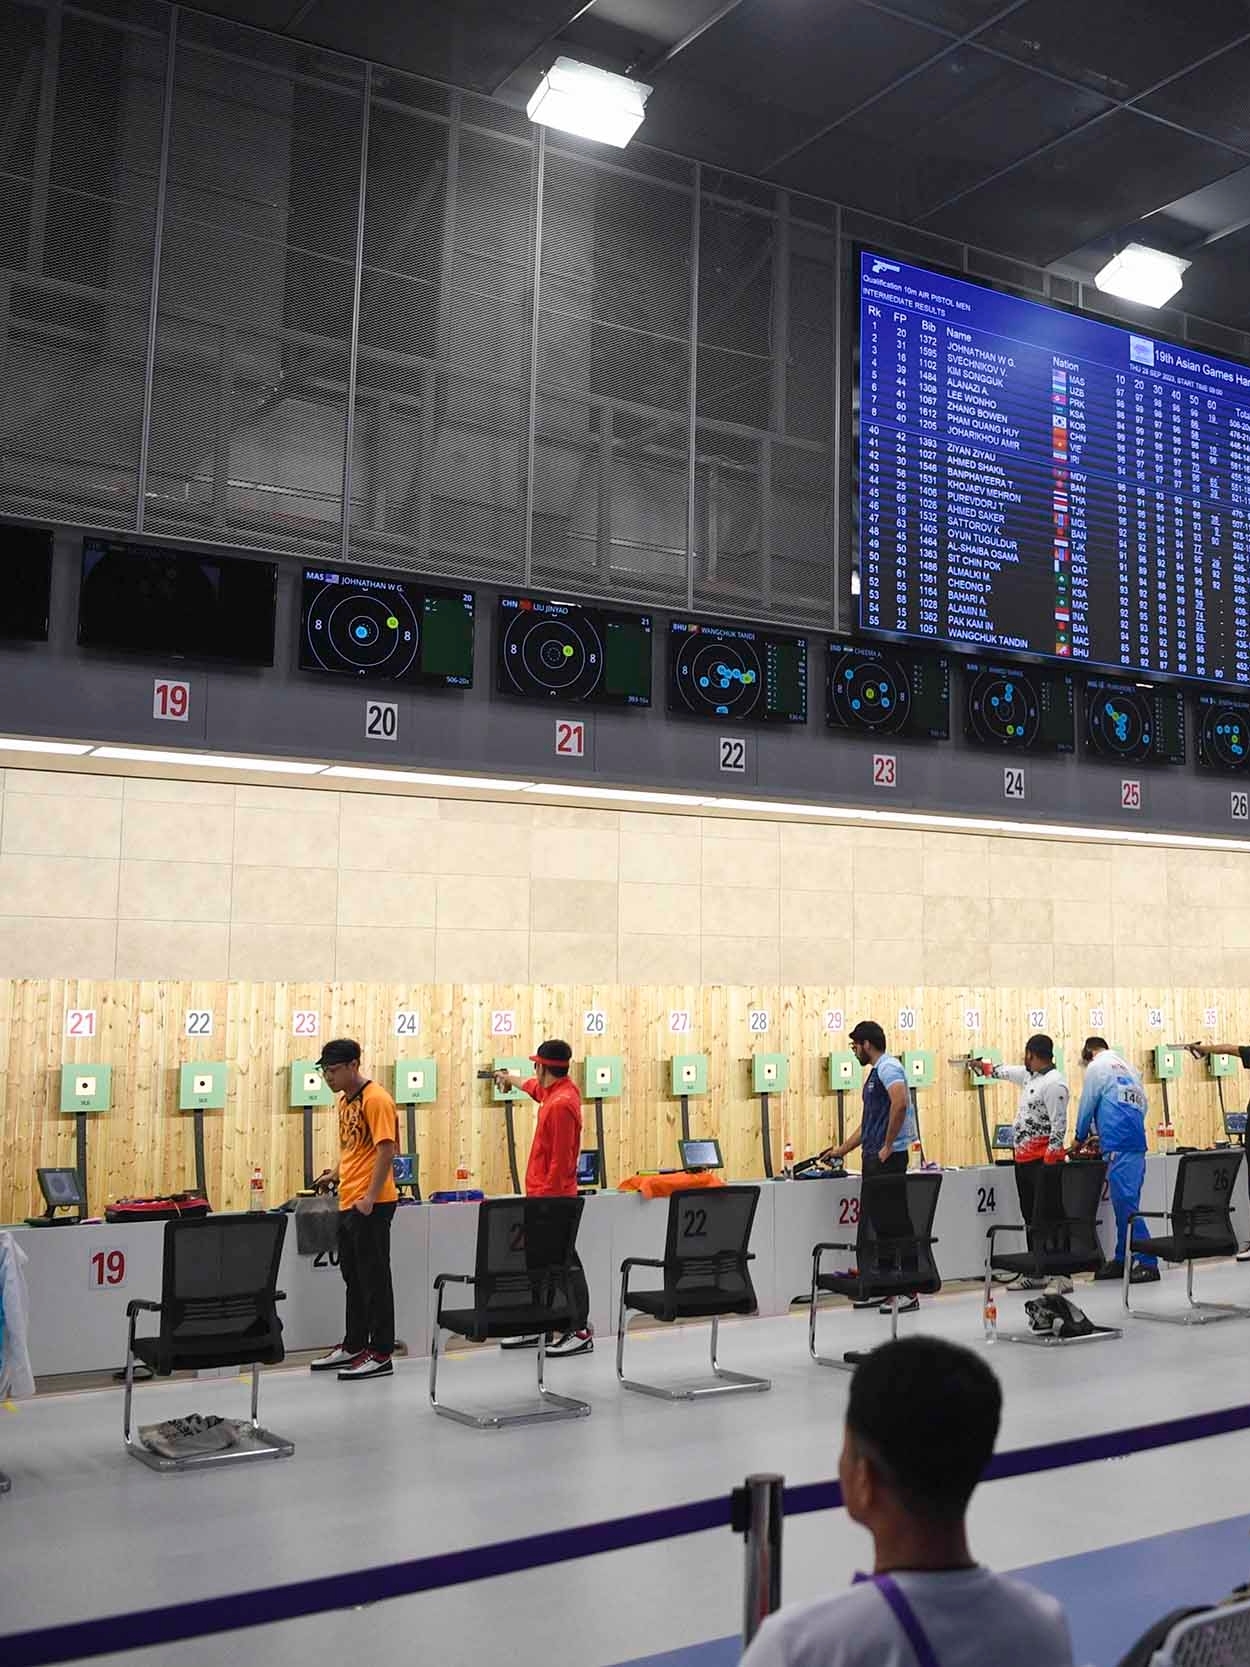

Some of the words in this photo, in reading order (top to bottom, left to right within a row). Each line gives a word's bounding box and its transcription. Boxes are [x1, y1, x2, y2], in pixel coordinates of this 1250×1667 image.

[863, 275, 902, 291] Qualification
[904, 286, 917, 296] 10m
[918, 290, 929, 299] AIR
[931, 294, 954, 308] PISTOL
[956, 301, 971, 311] MEN
[863, 289, 912, 308] INTERMEDIATE
[915, 302, 945, 316] RESULTS
[868, 305, 881, 317] Rk
[894, 312, 907, 323] FP
[922, 320, 936, 332] Bib
[947, 328, 971, 342] Name
[1053, 357, 1079, 372] Nation
[1115, 375, 1125, 385] 10
[1134, 380, 1144, 390] 20
[1153, 385, 1163, 395] 30
[1171, 390, 1181, 400] 40
[1190, 395, 1199, 405] 50
[1207, 400, 1216, 410] 60
[947, 344, 997, 363] JOHNATHAN
[998, 354, 1006, 364] W
[1008, 358, 1015, 367] G.
[1069, 375, 1085, 386] MAS
[1155, 350, 1174, 365] 19th
[1176, 355, 1200, 373] Asian
[1202, 365, 1234, 383] Games
[947, 354, 998, 373] SVECHNIKOV
[1000, 368, 1008, 377] V.
[1070, 386, 1085, 397] UZB
[1130, 364, 1142, 372] THU
[1150, 369, 1160, 377] SEP
[947, 366, 961, 377] KIM
[963, 370, 1003, 388] SONGGUK
[1070, 398, 1085, 408] PRK
[947, 379, 980, 392] ALANAZI
[982, 386, 989, 395] A.
[1070, 409, 1085, 420] KSA
[947, 391, 962, 400] LEE
[964, 395, 997, 409] WONHO
[1070, 421, 1086, 431] KOR
[947, 402, 976, 415] ZHANG
[978, 408, 1008, 424] BOWEN
[1070, 432, 1087, 443] CHN
[947, 414, 970, 426] PHAM
[972, 420, 1001, 434] QUANG
[1002, 428, 1020, 438] HUY
[1070, 444, 1085, 453] VIE
[947, 427, 999, 445] JOHARIKHOU
[1001, 438, 1020, 449] AMIR
[947, 443, 971, 456] ZIYAN
[972, 449, 996, 462] ZIYAU
[1070, 472, 1087, 482] MDV
[947, 456, 976, 469] AHMED
[978, 462, 1006, 476] SHAKIL
[1070, 484, 1086, 494] BAN
[948, 468, 1006, 488] BANPHAVEERA
[1071, 495, 1086, 505] THA
[948, 480, 985, 495] KHOJAEV
[987, 488, 1021, 503] MEHRON
[1071, 506, 1085, 516] TJK
[947, 504, 976, 519] AHMED
[978, 511, 1005, 524] SAKER
[948, 492, 997, 509] PUREVDORJ
[1071, 518, 1087, 529] MGL
[948, 518, 993, 532] SATTOROV
[948, 529, 972, 541] OYUN
[974, 534, 1017, 550] TUGULDUR
[948, 554, 961, 564] SIT
[962, 556, 982, 568] CHIN
[984, 560, 1001, 571] POK
[1071, 577, 1088, 587] MAC
[991, 551, 1019, 563] OSAMA
[1071, 565, 1087, 575] QAT
[307, 572, 324, 581] MAS
[342, 577, 386, 589] JOHNATHAN
[948, 567, 981, 579] ALMALKI
[1072, 589, 1087, 598] KSA
[948, 579, 984, 591] CHEONG
[502, 600, 518, 608] CHN
[534, 604, 544, 612] LIU
[545, 606, 568, 614] JINYAO
[948, 591, 978, 603] BAHARI
[1072, 612, 1085, 622] INA
[948, 604, 978, 615] ALAMIN
[315, 620, 322, 630] 8
[404, 631, 411, 640] 8
[949, 617, 964, 627] PAK
[966, 619, 984, 629] KAM
[985, 621, 993, 630] IN
[511, 644, 517, 654] 8
[948, 629, 997, 643] WANGCHUK
[999, 636, 1028, 648] TANDIN
[1072, 648, 1089, 658] BHU
[590, 654, 596, 663] 8
[682, 666, 688, 674] 8
[156, 684, 188, 717] 19
[368, 705, 395, 736] 20
[558, 724, 584, 752] 21
[721, 742, 744, 769] 22
[875, 758, 895, 784] 23
[1006, 772, 1023, 796] 24
[1123, 782, 1139, 807] 25
[1232, 796, 1247, 816] 26
[70, 1013, 95, 1034] 21
[188, 1013, 211, 1034] 22
[295, 1013, 316, 1033] 23
[397, 1014, 417, 1034] 24
[494, 1014, 513, 1032] 25
[585, 1014, 604, 1032] 26
[671, 1013, 688, 1031] 27
[751, 1013, 767, 1030] 28
[828, 1013, 842, 1029] 29
[900, 1012, 913, 1029] 30
[967, 1011, 980, 1029] 31
[1032, 1011, 1044, 1028] 32
[1091, 1011, 1103, 1026] 33
[1150, 1011, 1162, 1025] 34
[1205, 1011, 1216, 1025] 35
[840, 1199, 859, 1223] 23
[977, 1188, 996, 1213] 24
[685, 1210, 707, 1237] 22
[91, 1251, 126, 1285] 19
